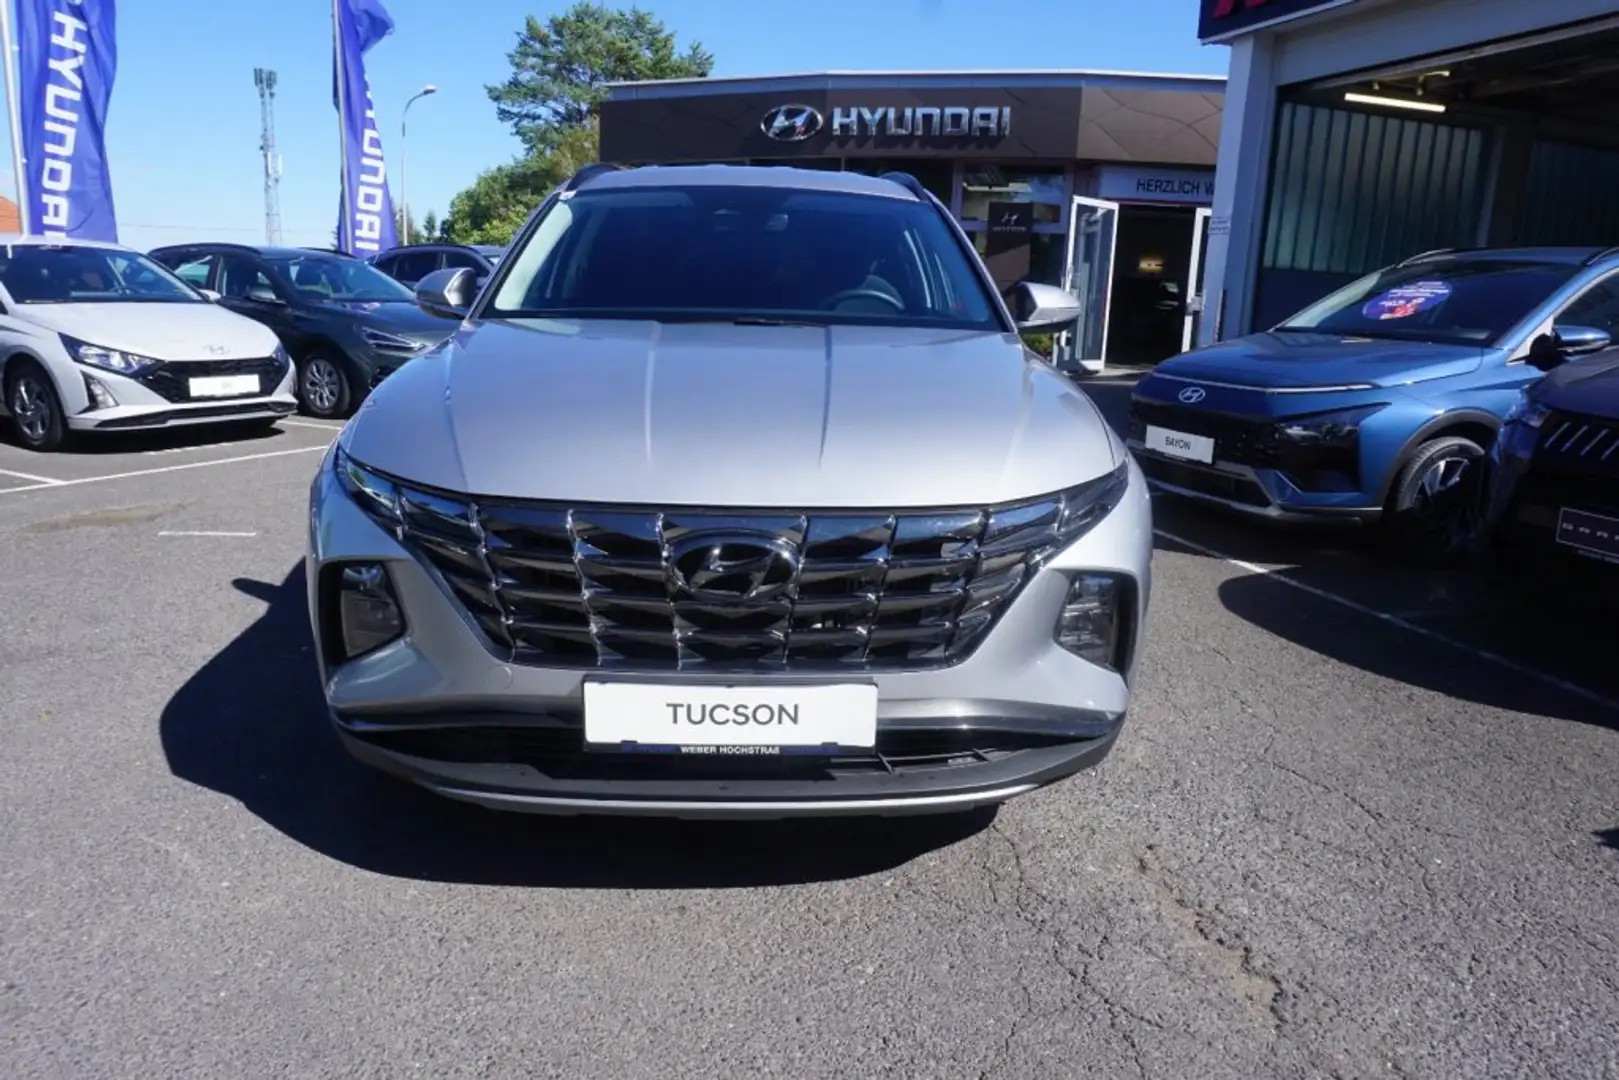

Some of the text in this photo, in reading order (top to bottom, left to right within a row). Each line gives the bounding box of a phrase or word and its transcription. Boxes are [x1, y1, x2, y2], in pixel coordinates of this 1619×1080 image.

[41, 11, 88, 239] HYUNDAI
[831, 105, 1011, 137] HYUNDAI
[1136, 178, 1200, 195] HERZLICH
[666, 702, 800, 726] TUCSON
[680, 745, 717, 755] WEBER
